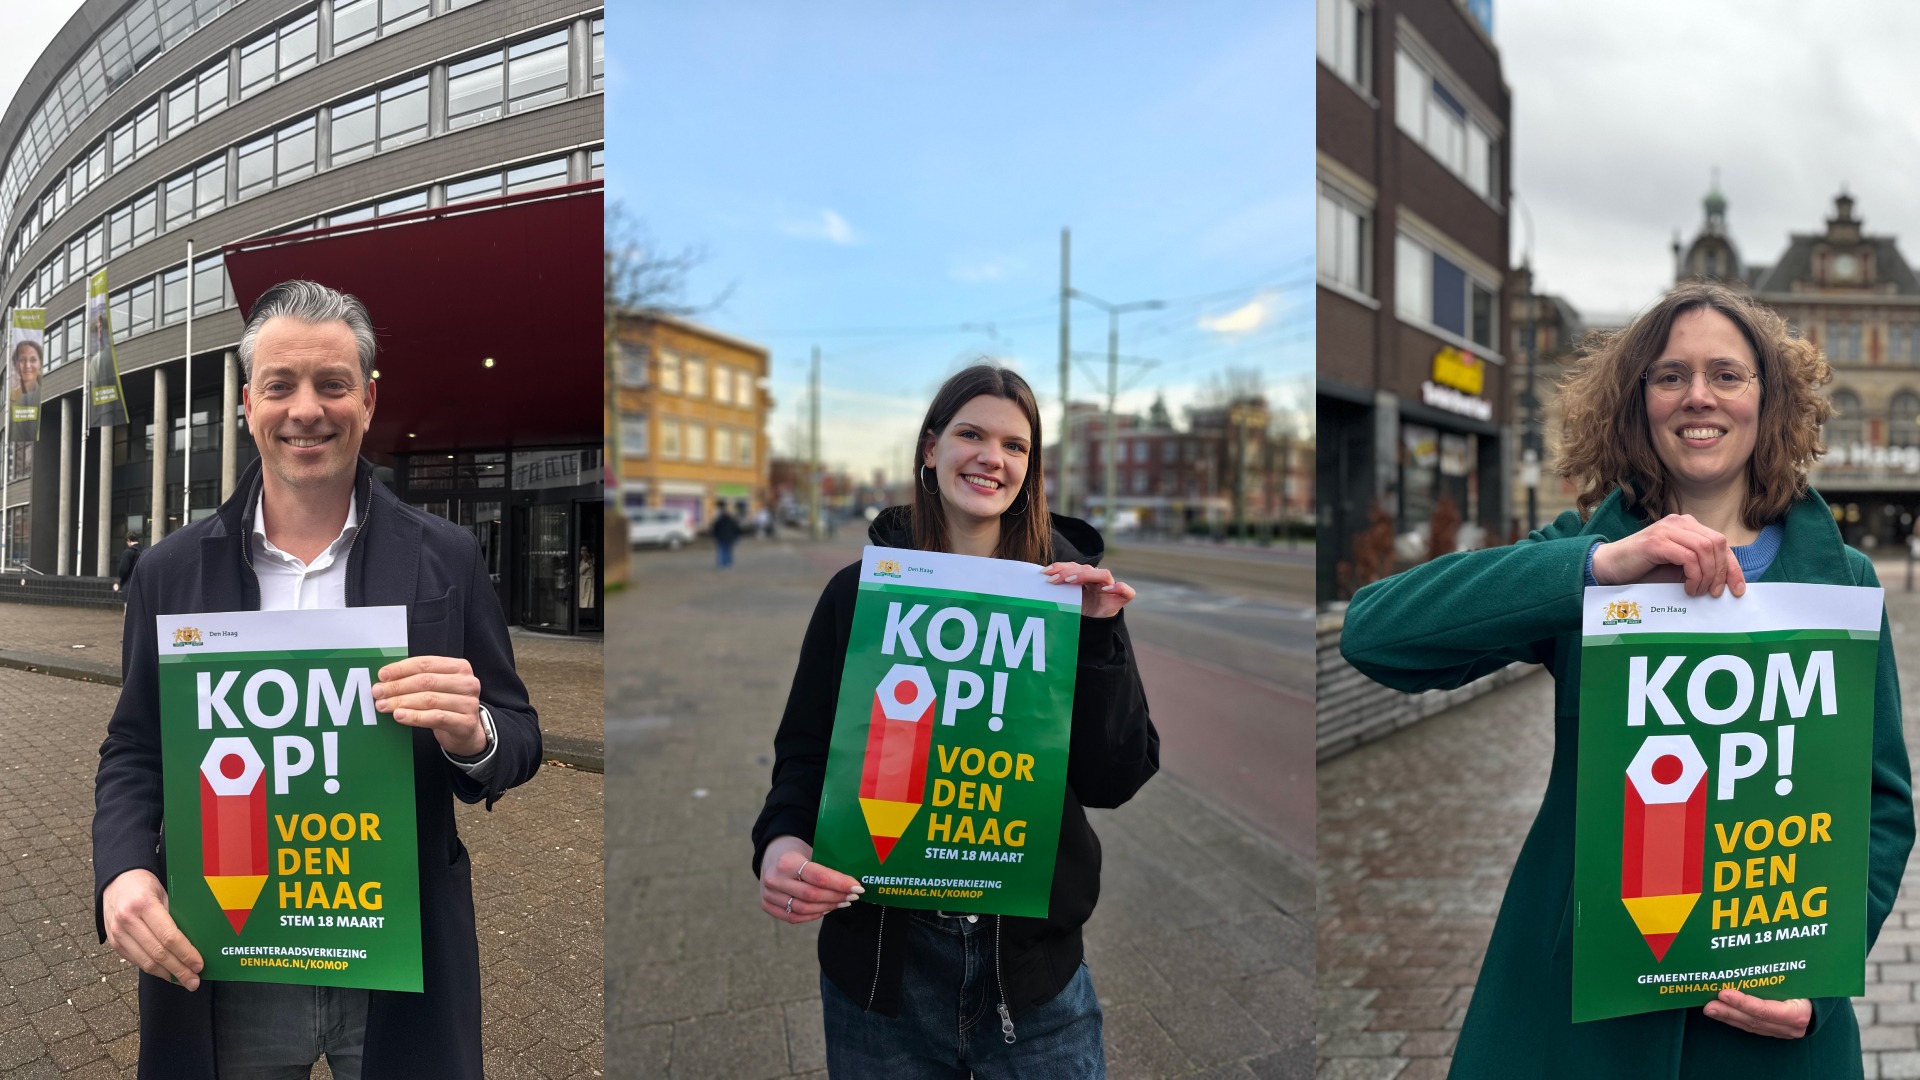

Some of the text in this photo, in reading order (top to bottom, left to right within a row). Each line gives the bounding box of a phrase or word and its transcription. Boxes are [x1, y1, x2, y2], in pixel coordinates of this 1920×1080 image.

[1667, 606, 1687, 614] Haag
[222, 630, 238, 638] Haag
[881, 602, 1046, 672] KOM
[196, 667, 378, 730] KOM
[876, 663, 1009, 732] OP!
[1627, 650, 1838, 726] KOM
[200, 732, 340, 796] OP!
[937, 744, 1035, 782] VOOR
[1625, 724, 1795, 804] OP!
[932, 778, 1002, 812] DEN
[274, 812, 382, 842] VOOR
[927, 813, 1027, 847] HAAG
[1714, 812, 1832, 854] VOOR
[278, 848, 350, 875] DEN
[925, 848, 1024, 864] STEM 18 MAART
[861, 875, 1002, 889] GEMEENTERAADSVERKIEZING
[1713, 853, 1796, 892] DEN
[278, 882, 382, 910] HAAG
[878, 887, 983, 898] DENHAAG.NL/KOMOP
[280, 916, 384, 928] STEM 18 MAART
[1711, 886, 1828, 930] HAAG
[1711, 923, 1828, 949] STEM 18 MAART
[221, 947, 367, 958] GEMEENTERAADSVERKIEZING
[240, 957, 349, 970] DENHAAG.NL/KOMOP
[1637, 960, 1806, 984] GEMEENTERAADSVERKIEZING
[1659, 974, 1786, 995] DENHAAG.NL/KOMOP
